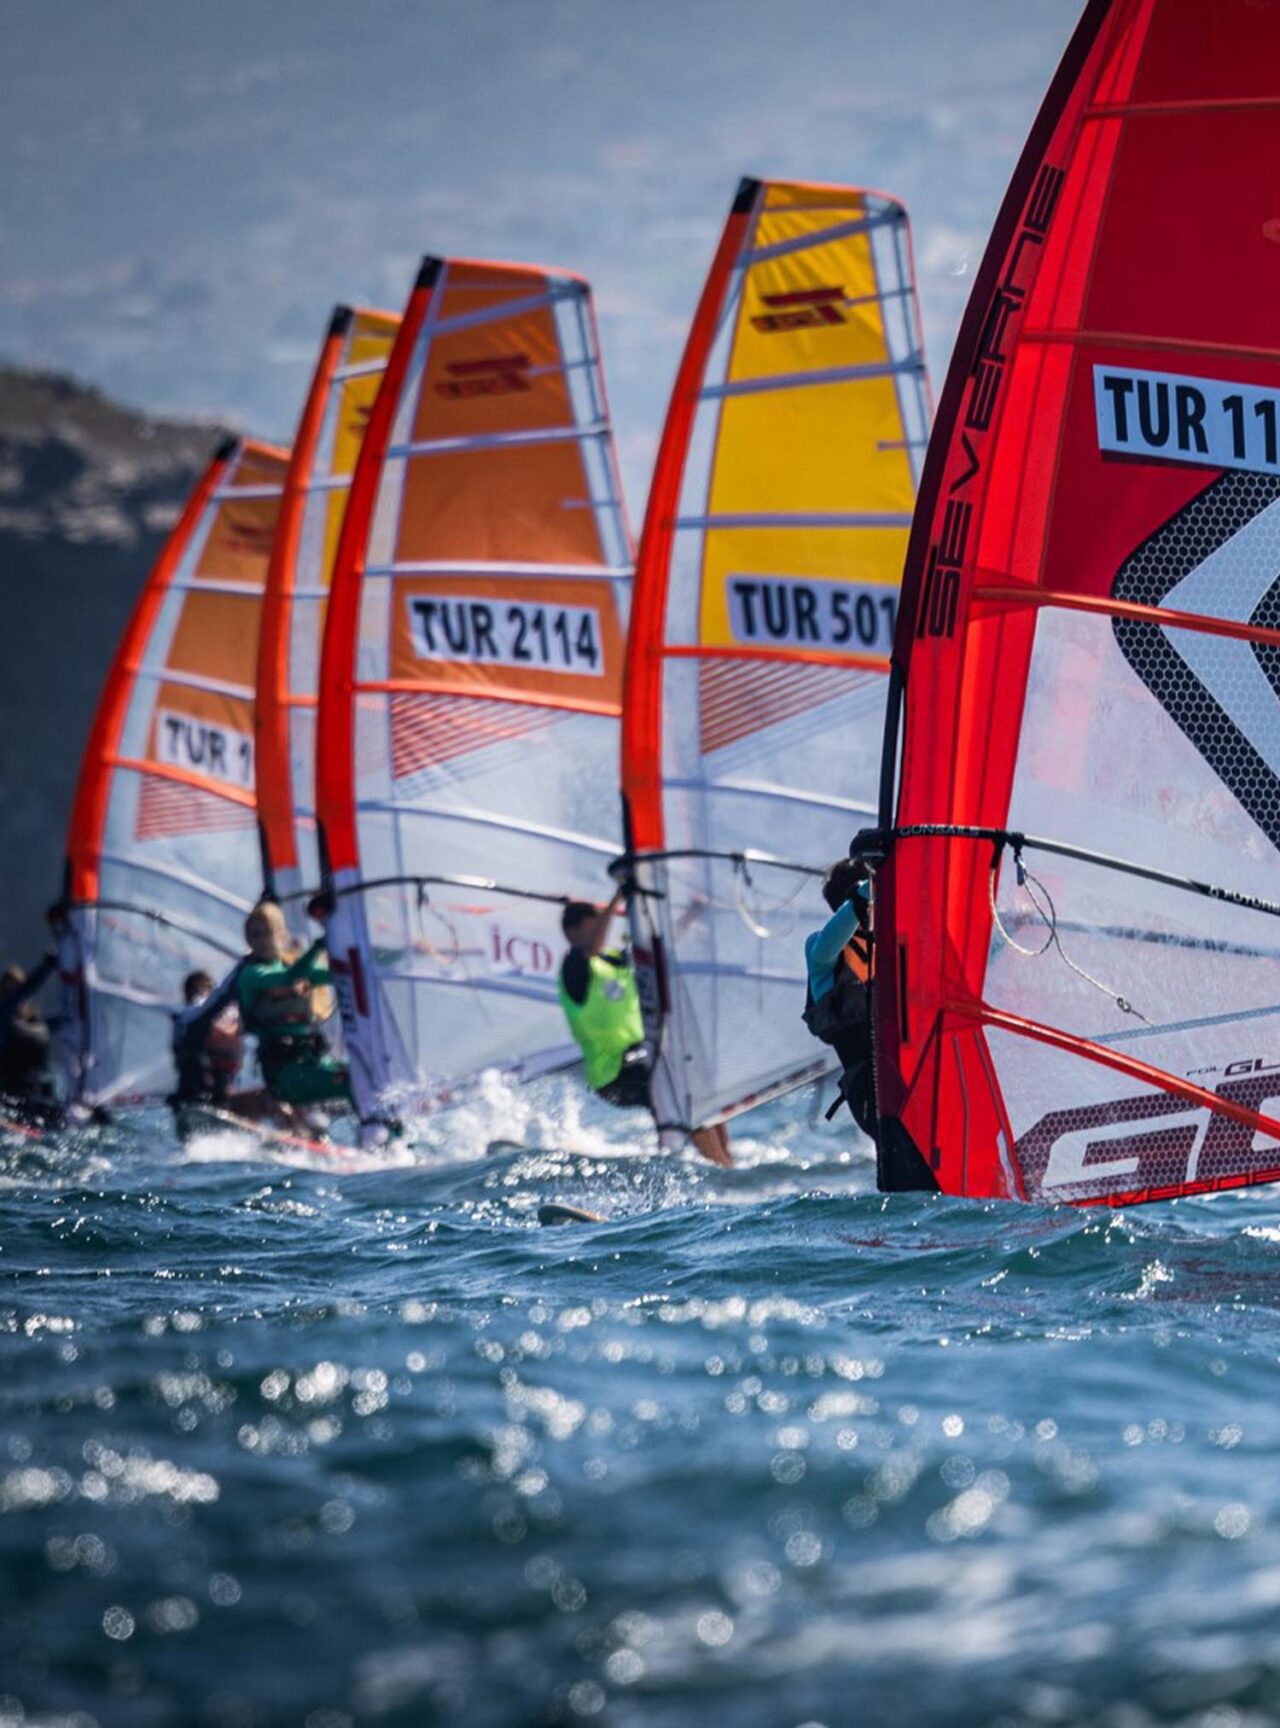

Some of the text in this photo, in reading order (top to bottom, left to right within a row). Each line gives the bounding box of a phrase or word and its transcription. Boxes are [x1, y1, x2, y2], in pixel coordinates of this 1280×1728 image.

[929, 163, 1065, 638] SEVERNE
[1103, 374, 1209, 454] TUR
[413, 601, 598, 668] TUR 2114
[733, 582, 821, 642] TUR
[166, 717, 228, 775] TUR
